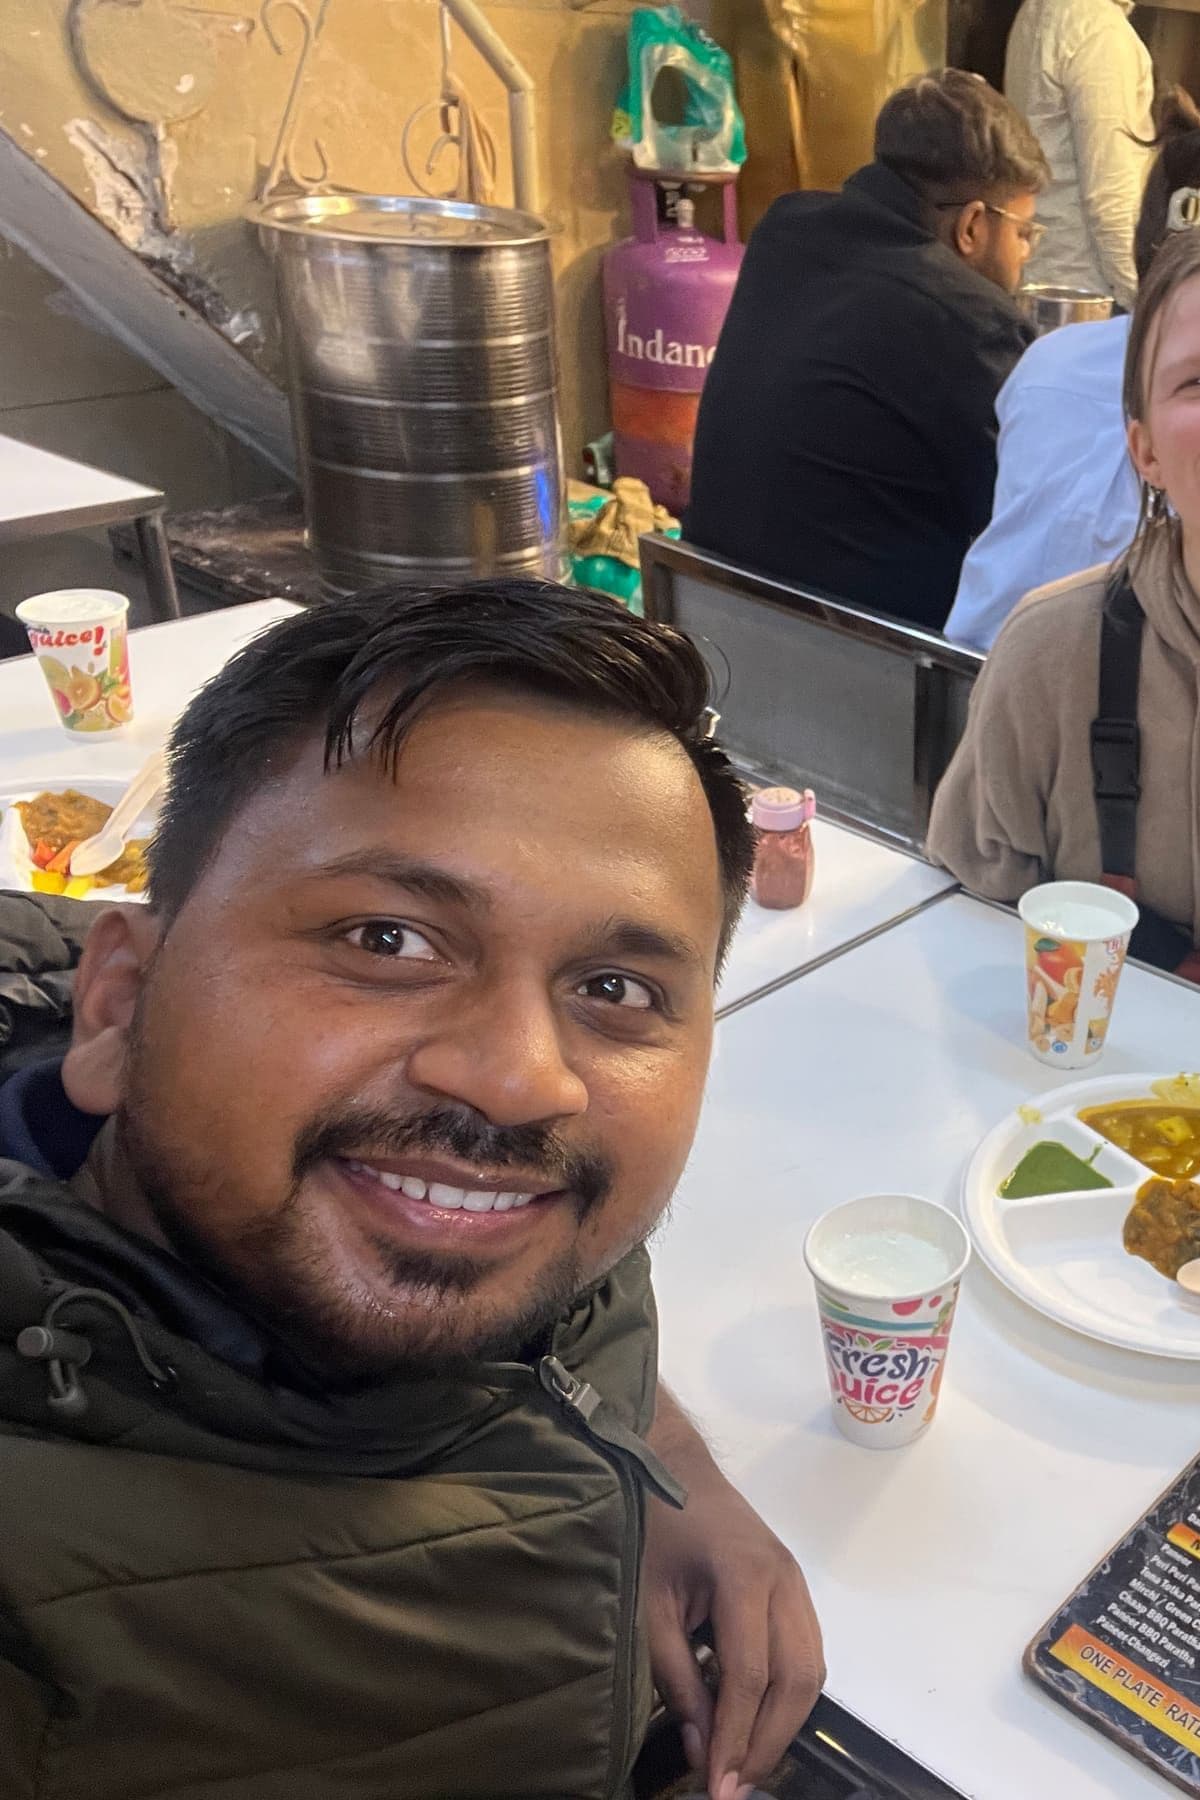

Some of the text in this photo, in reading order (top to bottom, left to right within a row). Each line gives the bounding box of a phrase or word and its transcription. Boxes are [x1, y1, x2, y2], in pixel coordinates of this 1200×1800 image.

[1107, 1602, 1140, 1629] Paneer
[1137, 1622, 1160, 1643] BBQ
[1157, 1635, 1195, 1666] Paratha
[1146, 1608, 1169, 1629] BBQ
[1164, 1601, 1193, 1624] Green
[1080, 1643, 1114, 1674] ONE
[1112, 1667, 1164, 1707] PLATE
